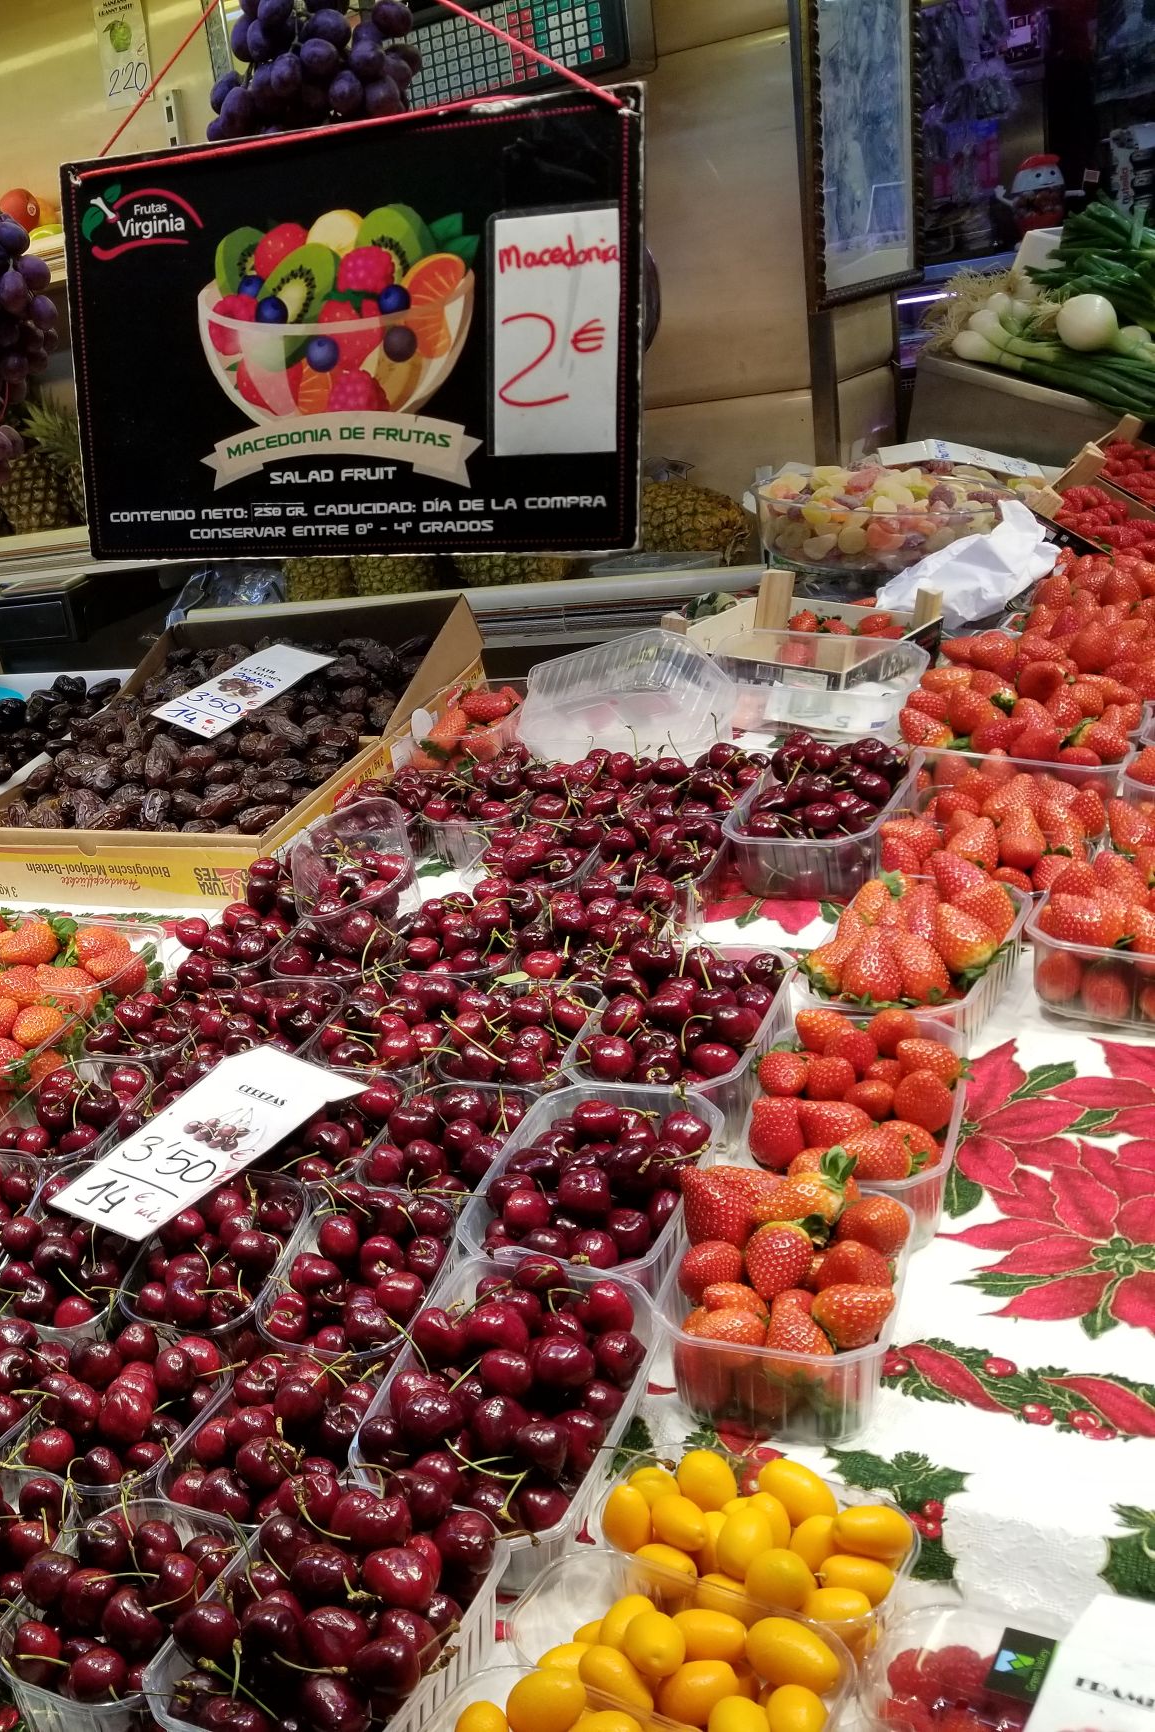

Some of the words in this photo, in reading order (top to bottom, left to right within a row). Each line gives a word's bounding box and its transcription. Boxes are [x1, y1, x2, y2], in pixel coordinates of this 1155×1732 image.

[134, 203, 167, 215] Frutas
[117, 213, 186, 239] Virginia
[498, 233, 620, 273] Macedonia
[498, 312, 569, 407] 2
[226, 427, 331, 459] MACEDONIA
[340, 427, 365, 440] DE
[373, 427, 451, 448] FRUTAS
[269, 469, 334, 485] SALAD
[340, 466, 397, 481] FRUIT
[110, 509, 195, 523] CONTENIDO
[201, 508, 248, 520] NETO:
[254, 507, 281, 517] 250
[314, 501, 416, 517] CADUCIDAD:
[422, 498, 452, 513] DÍA
[458, 499, 484, 511] DE
[491, 498, 517, 511] LA
[525, 495, 607, 509] COMPRA
[190, 526, 286, 540] CONSERVAR
[292, 524, 349, 537] ENTRE
[419, 520, 494, 533] GRADOS
[186, 692, 241, 715] 3'50
[165, 709, 197, 725] 14
[25, 861, 108, 878] Medjool-Datteln
[109, 861, 170, 879] Biologische
[11, 886, 18, 898] 3
[61, 875, 141, 892] Handgepflückte
[239, 1084, 287, 1107] CEREZAS
[123, 1136, 217, 1183] 3'50
[75, 1180, 126, 1214] 14
[1026, 1670, 1041, 1692] Green
